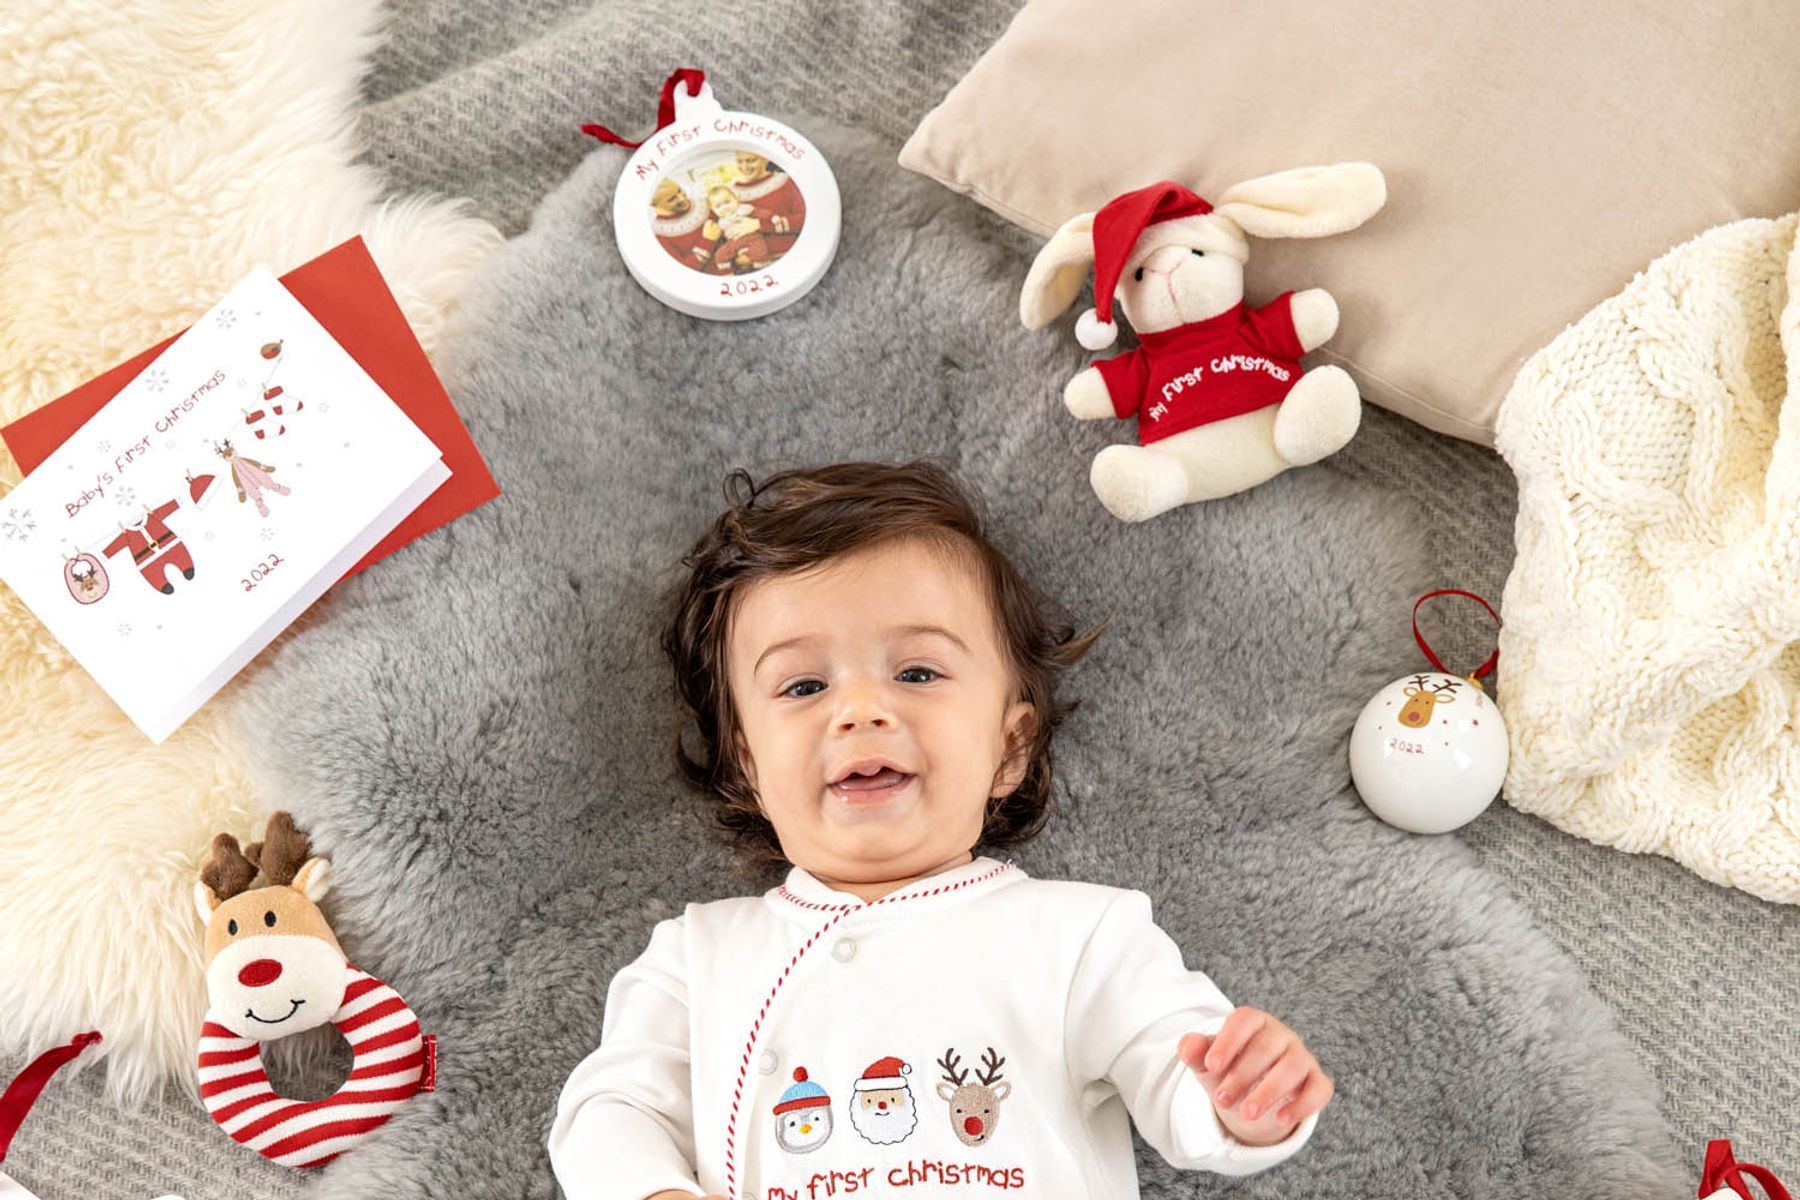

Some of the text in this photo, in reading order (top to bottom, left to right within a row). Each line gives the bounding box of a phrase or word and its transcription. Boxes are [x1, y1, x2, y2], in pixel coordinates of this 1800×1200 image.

[714, 119, 807, 161] Christmas
[720, 274, 779, 297] 2022
[1161, 366, 1204, 402] First
[1210, 354, 1291, 382] Christmas
[65, 369, 227, 518] Baby's First Christmas
[240, 553, 285, 592] 2022
[1390, 737, 1425, 755] 2022
[806, 1167, 875, 1200] first
